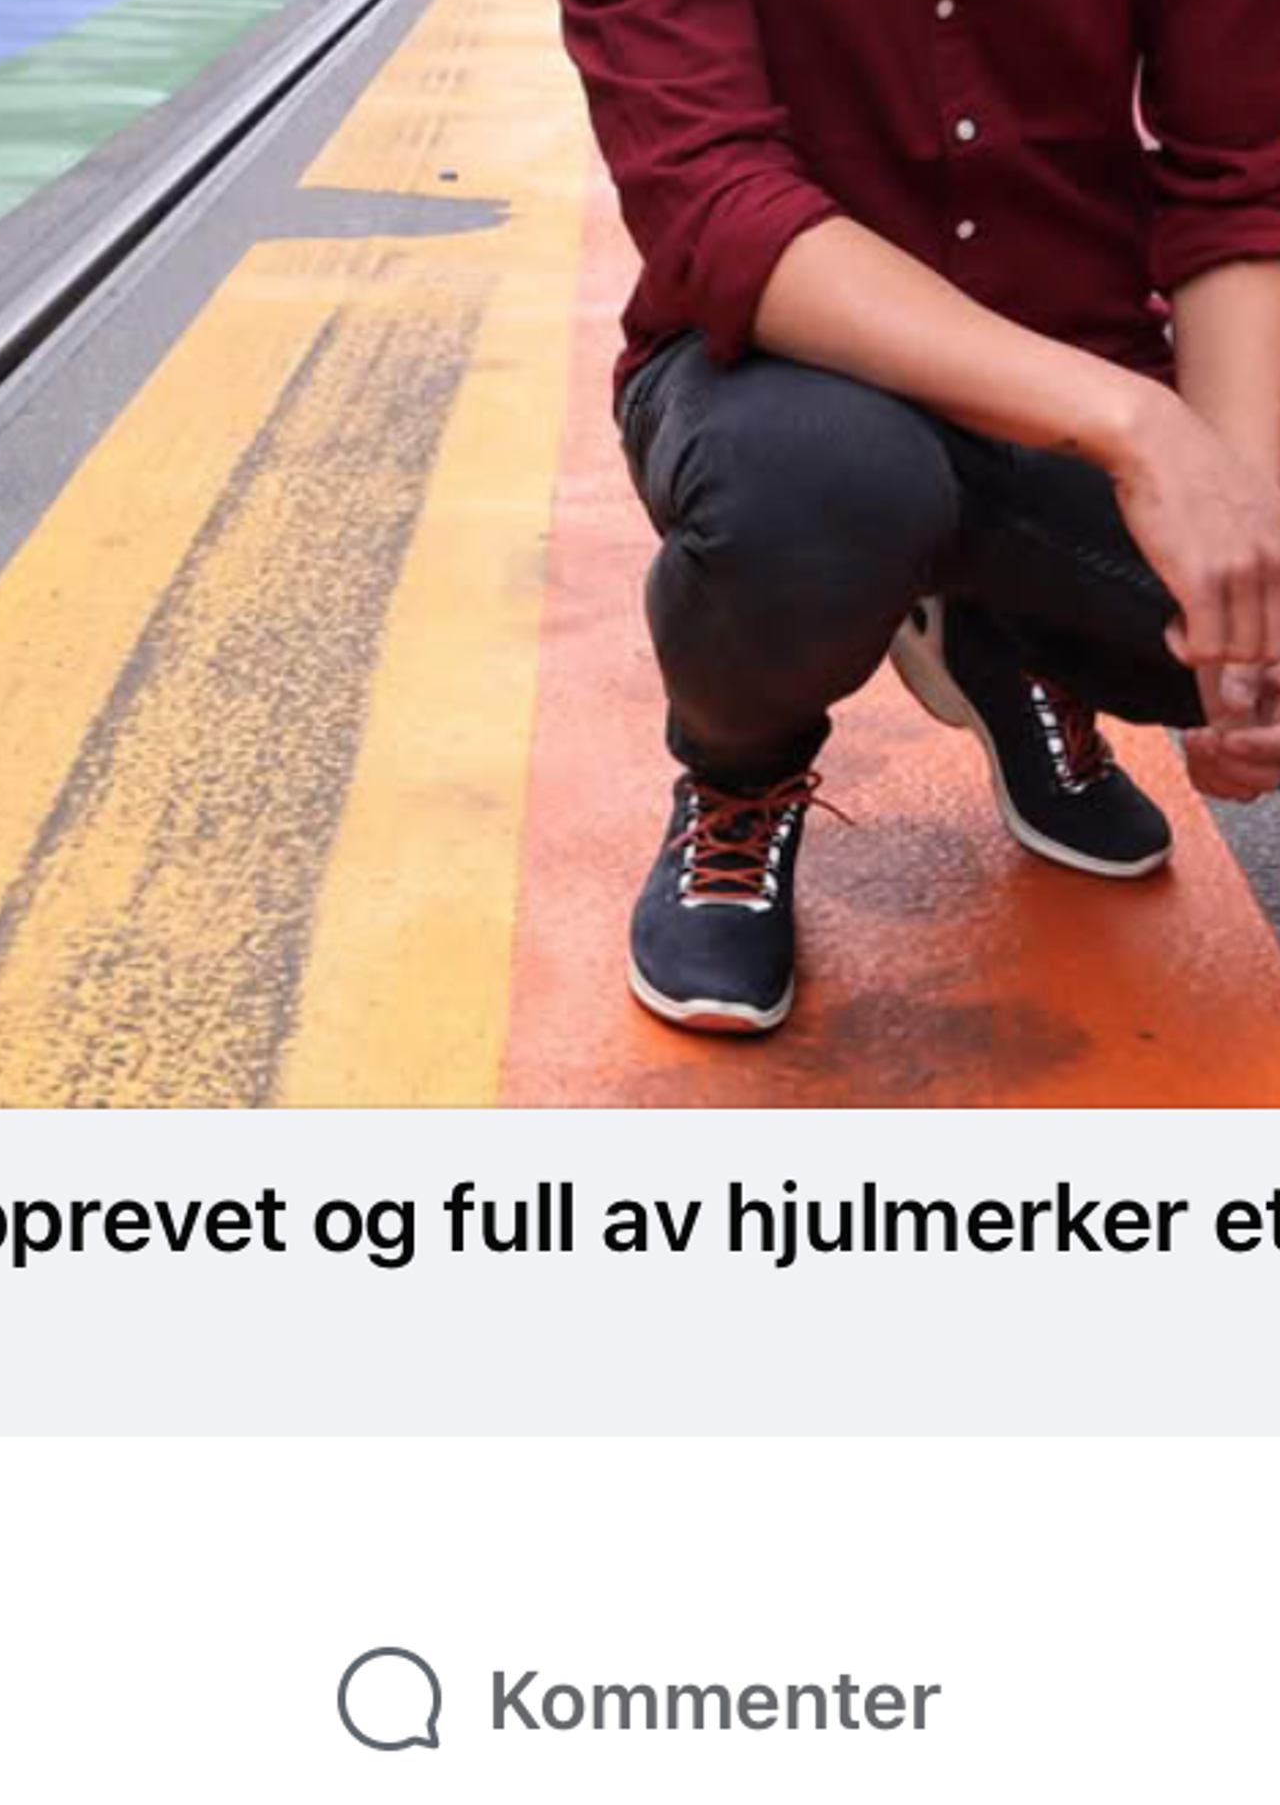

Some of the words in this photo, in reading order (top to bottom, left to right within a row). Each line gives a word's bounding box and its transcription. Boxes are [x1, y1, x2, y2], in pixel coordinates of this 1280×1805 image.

[313, 1198, 416, 1270] og
[442, 1180, 574, 1254] full
[602, 1198, 703, 1253] av
[728, 1178, 1190, 1269] hjulmerker
[492, 1670, 942, 1731] Kommenter
